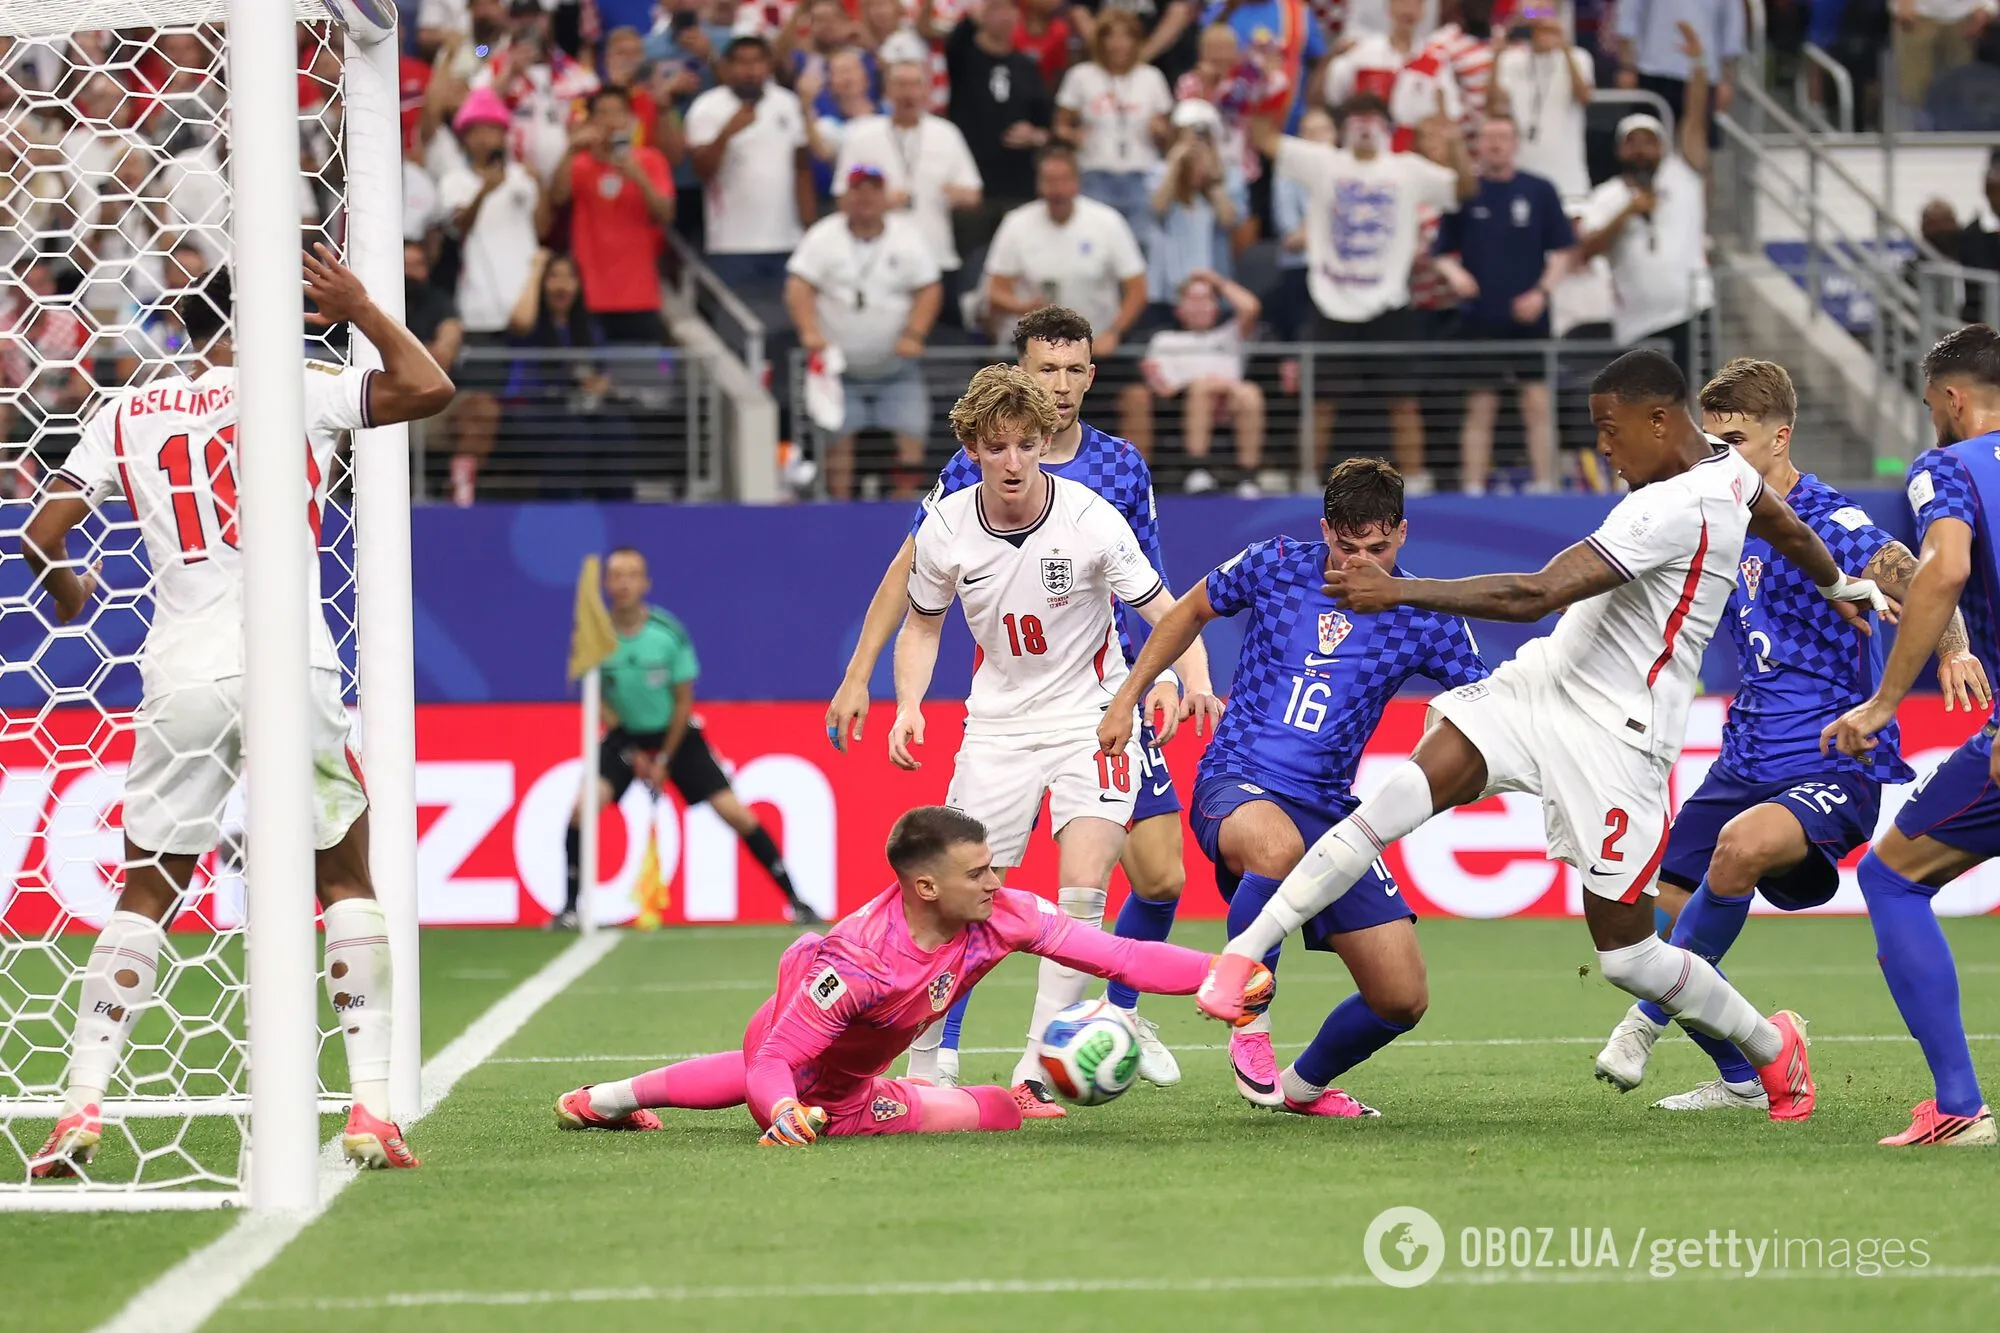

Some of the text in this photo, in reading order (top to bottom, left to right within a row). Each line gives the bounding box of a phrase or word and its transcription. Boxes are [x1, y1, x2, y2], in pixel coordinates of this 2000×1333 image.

[1002, 612, 1048, 656] 18
[1282, 675, 1332, 733] 16
[1093, 749, 1131, 793] 18
[1600, 807, 1629, 862] 2
